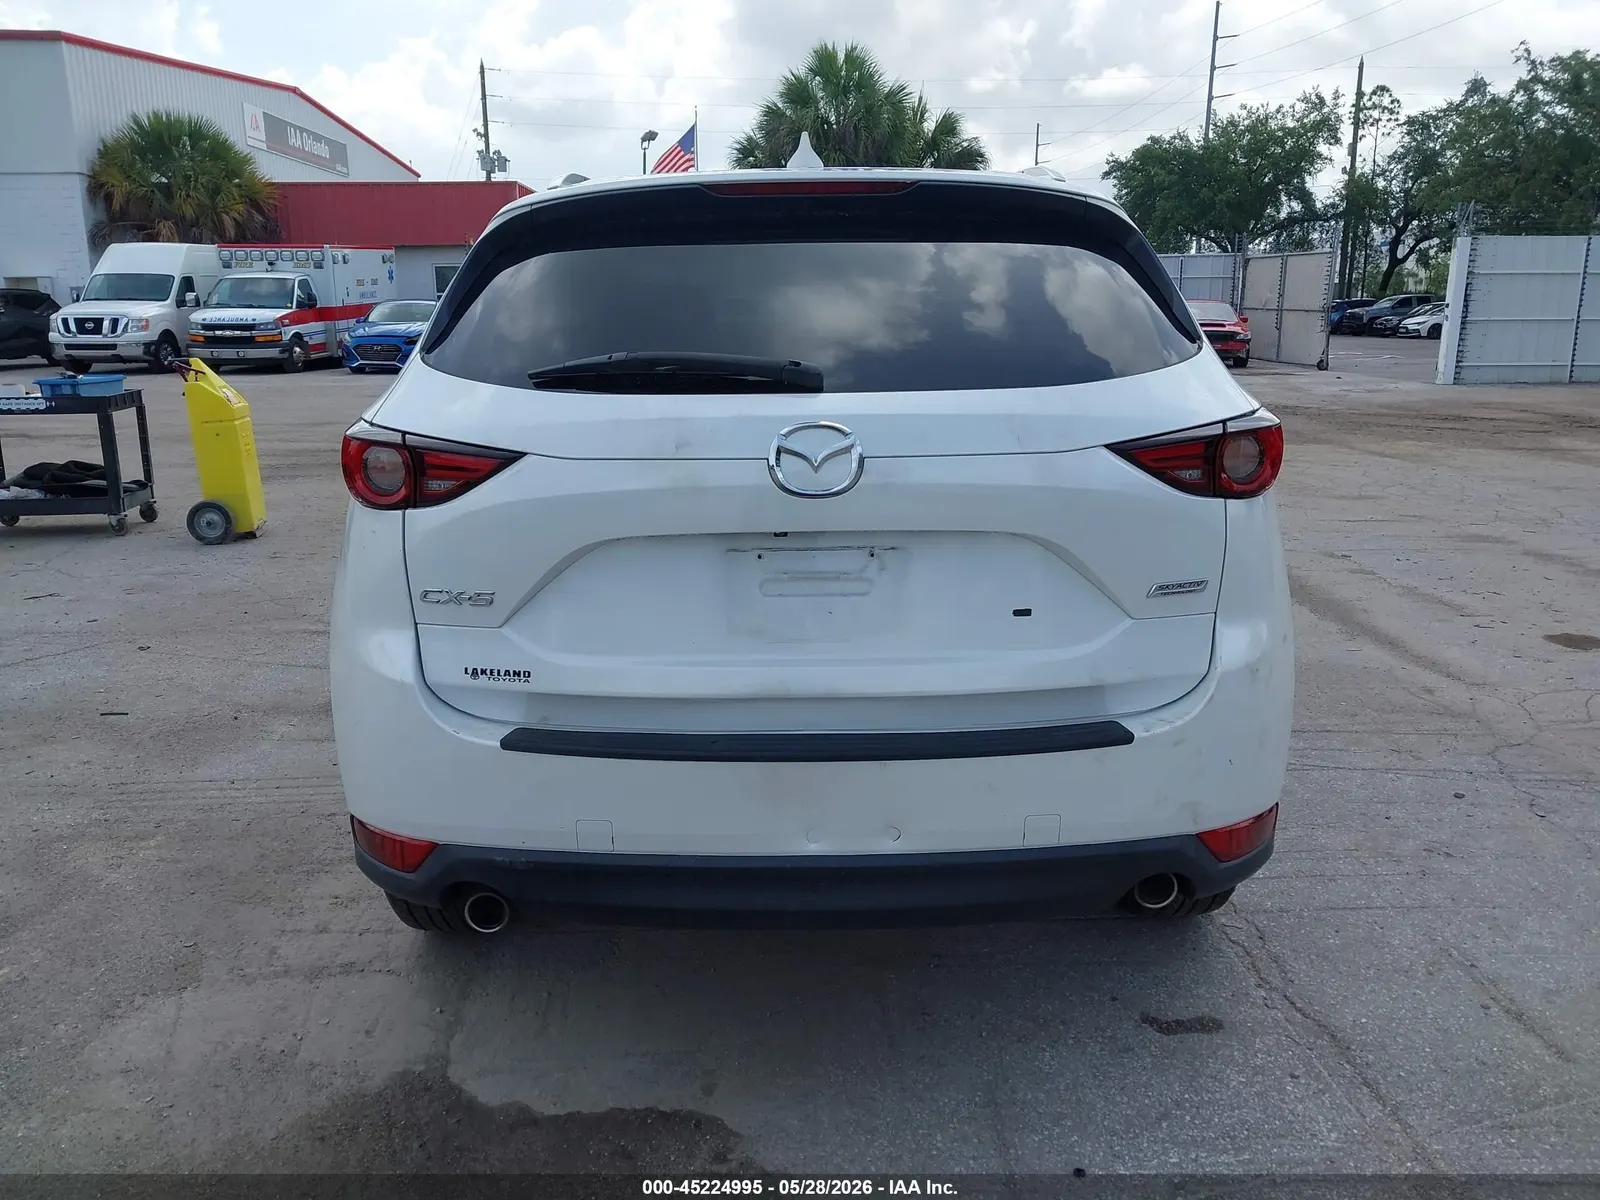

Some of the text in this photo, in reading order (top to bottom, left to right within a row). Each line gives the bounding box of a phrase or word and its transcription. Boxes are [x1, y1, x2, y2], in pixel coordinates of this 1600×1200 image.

[287, 126, 330, 159] IAA Orlando
[1158, 581, 1203, 590] SKYACTIV
[420, 588, 495, 606] CX-5
[464, 667, 531, 679] LAKELAND
